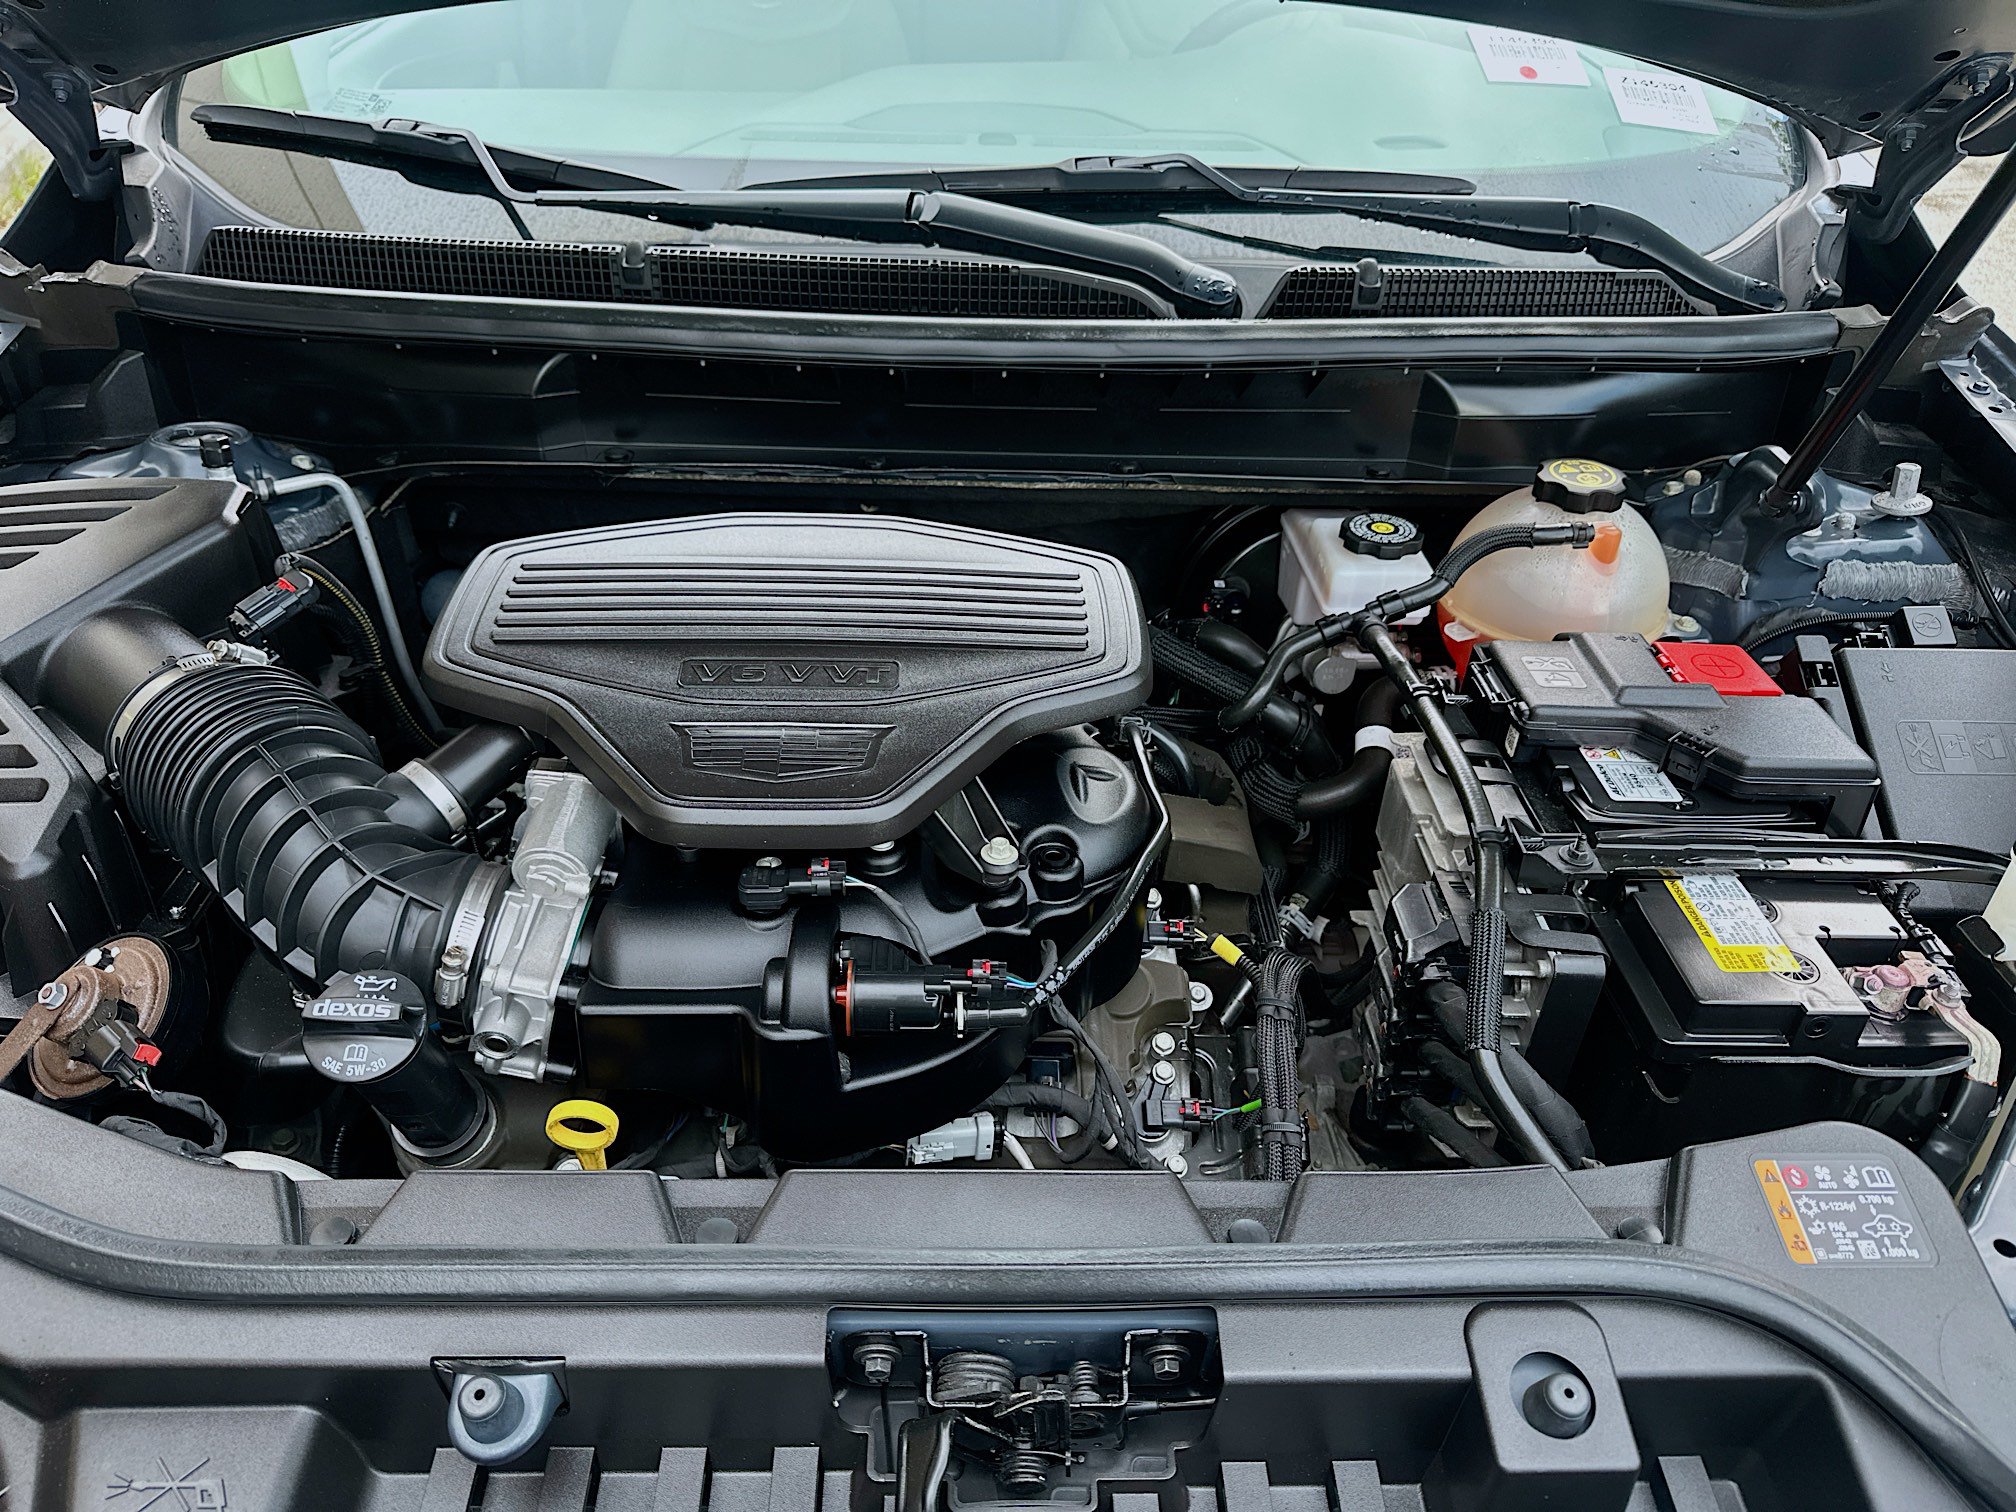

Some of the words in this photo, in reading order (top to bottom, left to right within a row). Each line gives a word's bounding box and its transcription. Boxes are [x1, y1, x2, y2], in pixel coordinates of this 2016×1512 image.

[691, 663, 766, 683] V6
[779, 663, 891, 684] VVT
[1685, 902, 1708, 933] DANGER
[312, 998, 391, 1018] dexos
[321, 1056, 344, 1074] SAE
[345, 1057, 387, 1077] 5W-30
[1818, 1181, 1838, 1189] AUTO
[1881, 1195, 1895, 1206] kg
[1827, 1221, 1848, 1232] PAG
